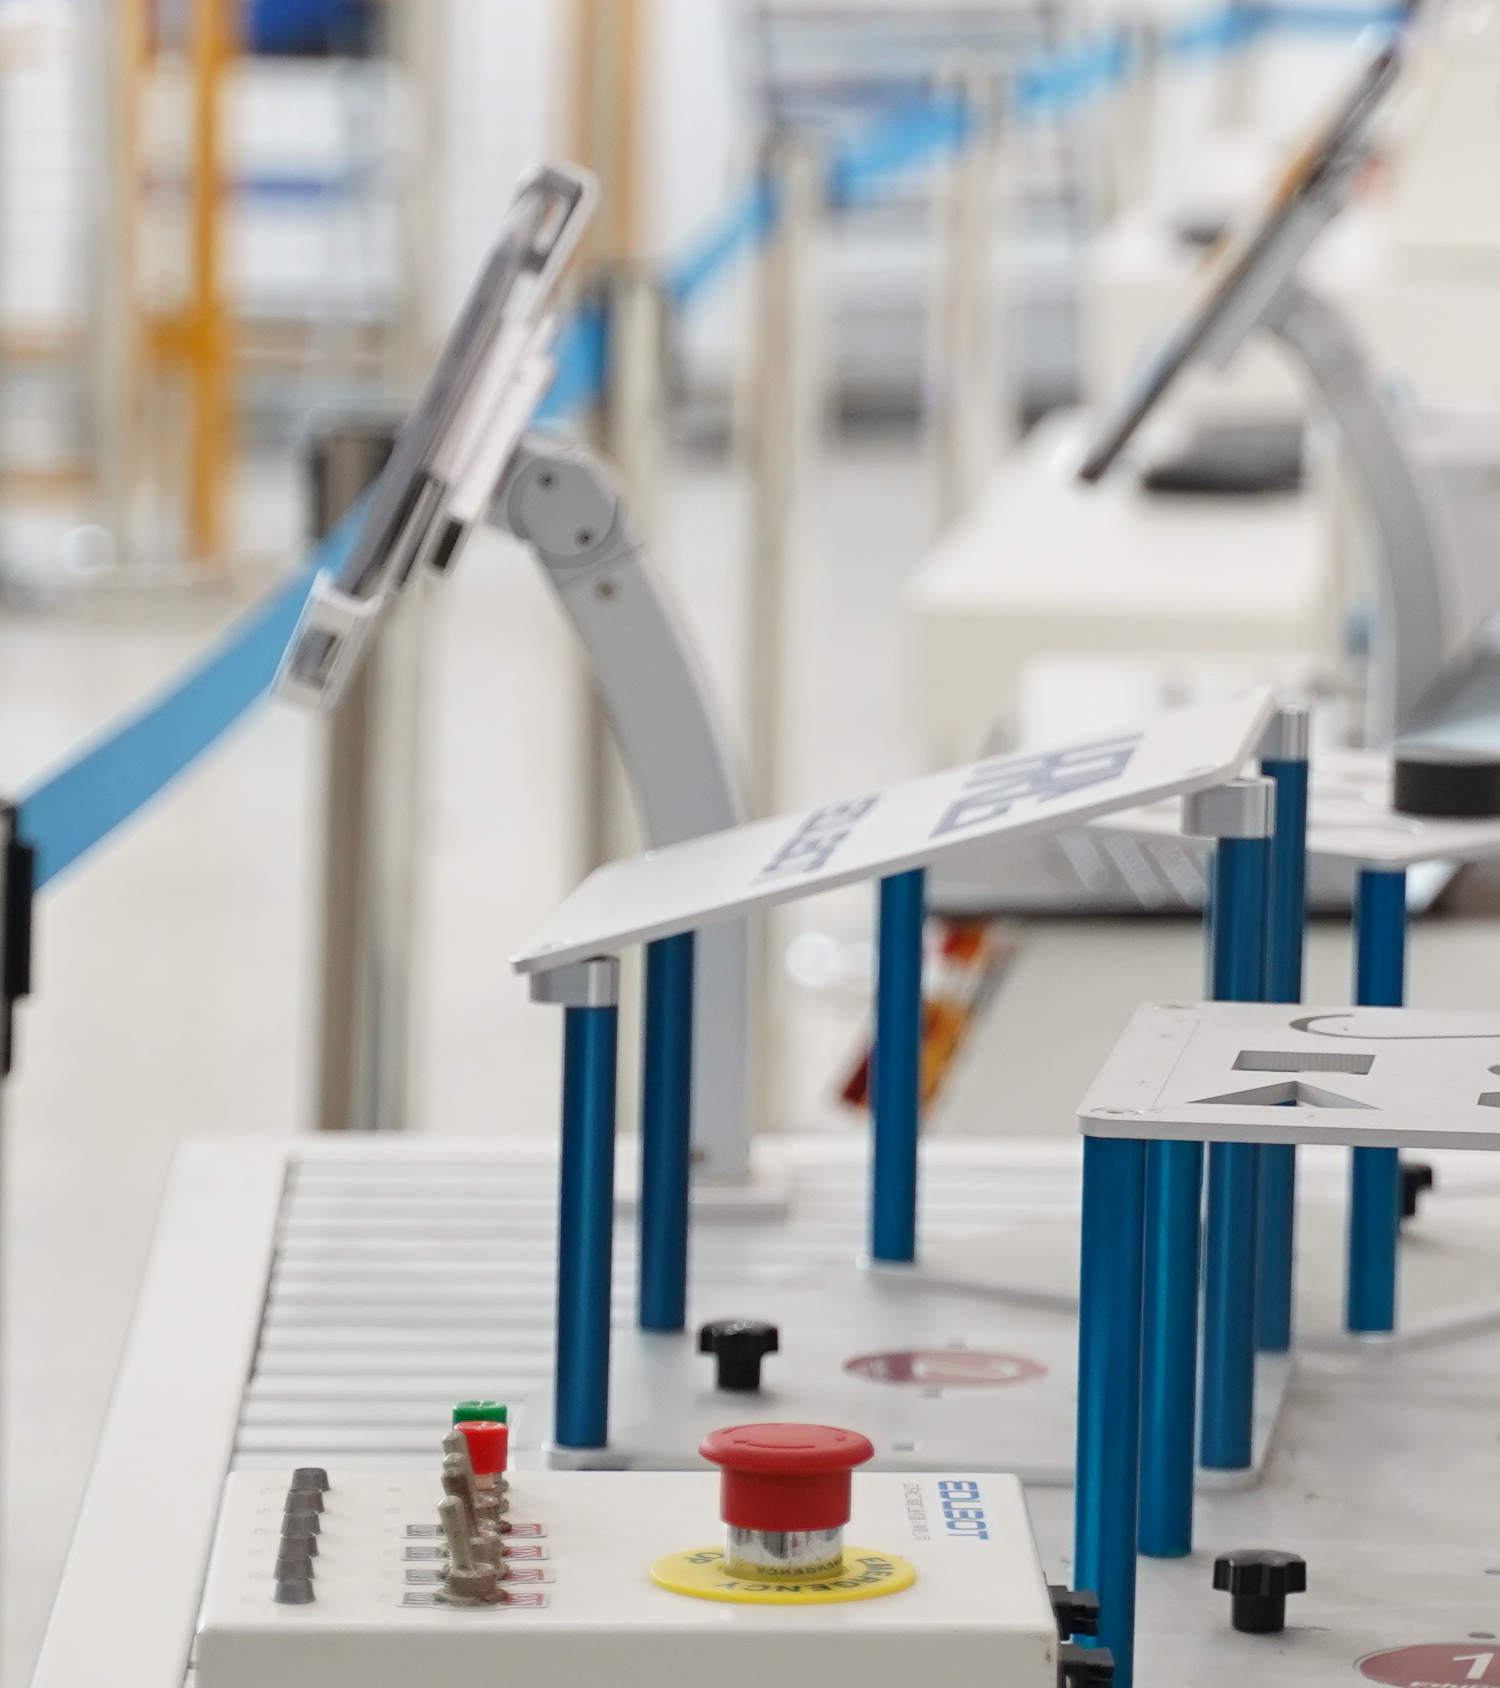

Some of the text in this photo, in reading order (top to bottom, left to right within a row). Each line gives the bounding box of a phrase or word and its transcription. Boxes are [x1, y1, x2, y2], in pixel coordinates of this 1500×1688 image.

[938, 1480, 989, 1540] EDUBOT
[715, 1557, 894, 1593] EMERGENCY
[1452, 1652, 1495, 1680] 1
